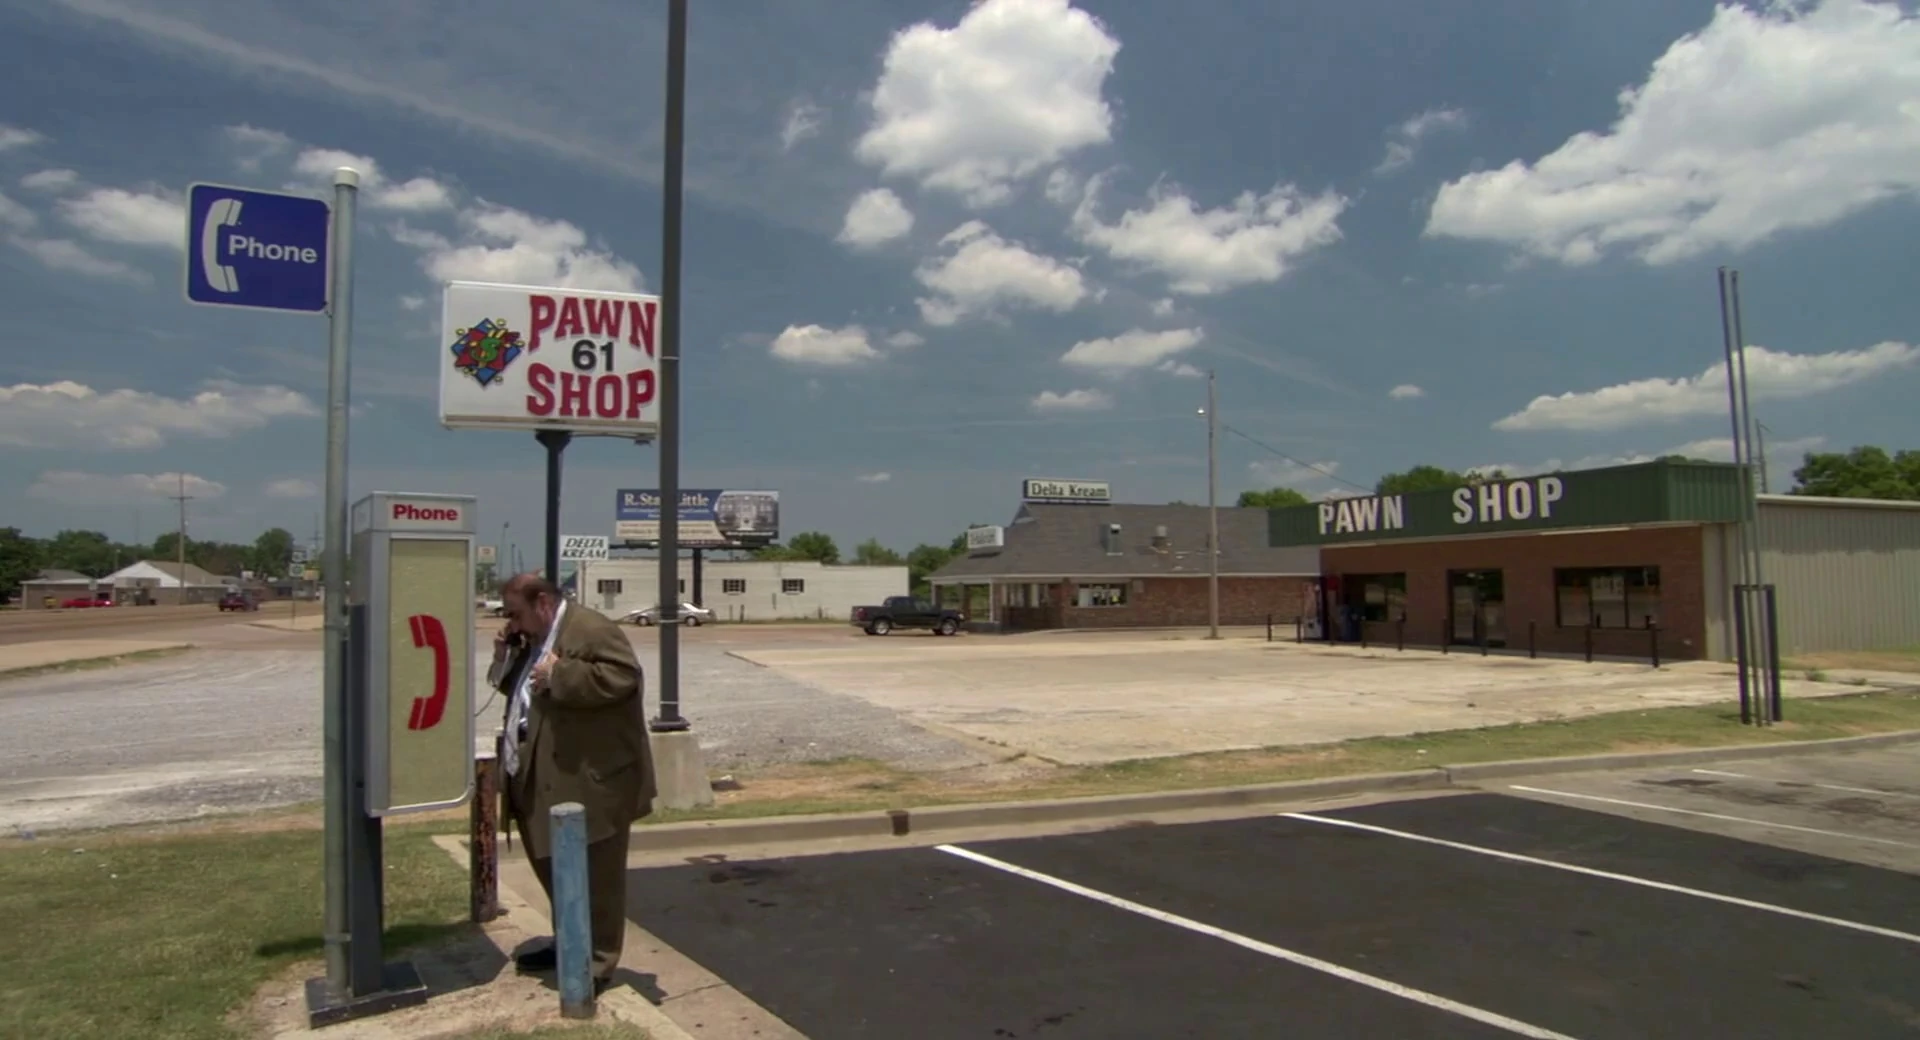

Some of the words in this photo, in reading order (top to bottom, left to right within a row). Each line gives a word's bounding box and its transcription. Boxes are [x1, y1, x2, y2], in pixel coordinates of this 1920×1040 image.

[228, 234, 318, 264] Phone
[528, 294, 657, 358] PAWN
[571, 339, 615, 372] 61
[526, 362, 655, 419] SHOP
[1031, 482, 1064, 496] Delta
[1068, 483, 1107, 497] Kream
[392, 503, 458, 521] Phone
[1318, 495, 1403, 535] PAWN
[1452, 477, 1563, 525] SHOP
[562, 549, 607, 559] KREAM
[565, 537, 605, 549] DELTA
